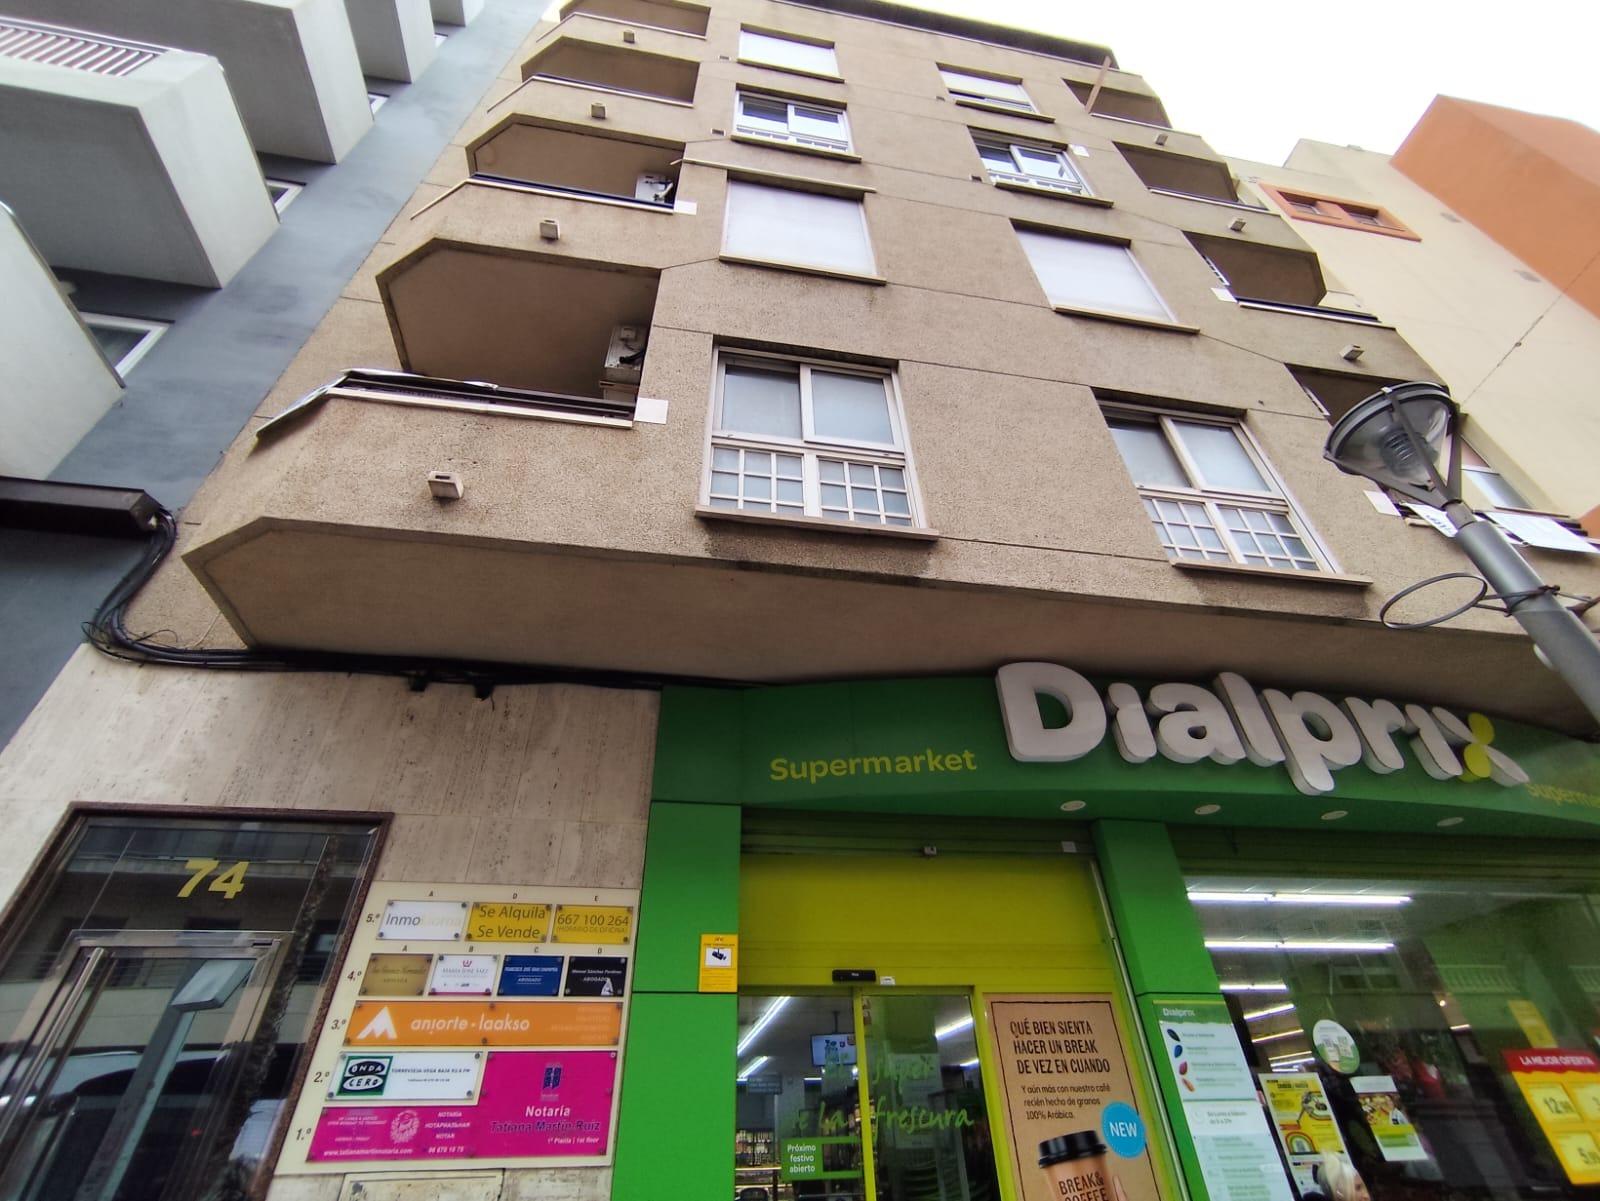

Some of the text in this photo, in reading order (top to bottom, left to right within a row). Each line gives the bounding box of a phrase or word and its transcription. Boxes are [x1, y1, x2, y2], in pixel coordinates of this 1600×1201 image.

[995, 662, 1530, 796] Dialprix
[769, 749, 977, 785] Supermarket
[177, 858, 249, 899] 74
[479, 905, 546, 920] Se Alquila
[557, 914, 629, 927] 667 100 264
[477, 925, 540, 938] Se Vende
[479, 1013, 530, 1031] laakso
[1010, 1018, 1093, 1038] QUÉ BIEN SIENTA
[1013, 1040, 1098, 1054] HACER UN BREAK
[1016, 1058, 1111, 1074] DE VEZ EN CUANDO
[1518, 1055, 1595, 1066] LA MEJOR OFERTA
[351, 1063, 382, 1073] ONDA
[348, 1077, 379, 1087] CERO
[1027, 1084, 1041, 1094] aún
[1070, 1084, 1095, 1092] nuestro
[1096, 1082, 1111, 1092] café
[1024, 1097, 1045, 1106] recién
[1046, 1097, 1065, 1106] hecho
[1066, 1097, 1075, 1105] de
[525, 1105, 571, 1117] Notaría
[1026, 1110, 1046, 1120] 100%
[575, 1120, 600, 1131] Ruiz
[872, 1096, 974, 1146] frescura
[1109, 1122, 1137, 1137] NEW
[787, 1143, 816, 1153] Próximo
[790, 1153, 815, 1163] festivo
[789, 1163, 816, 1173] abierto
